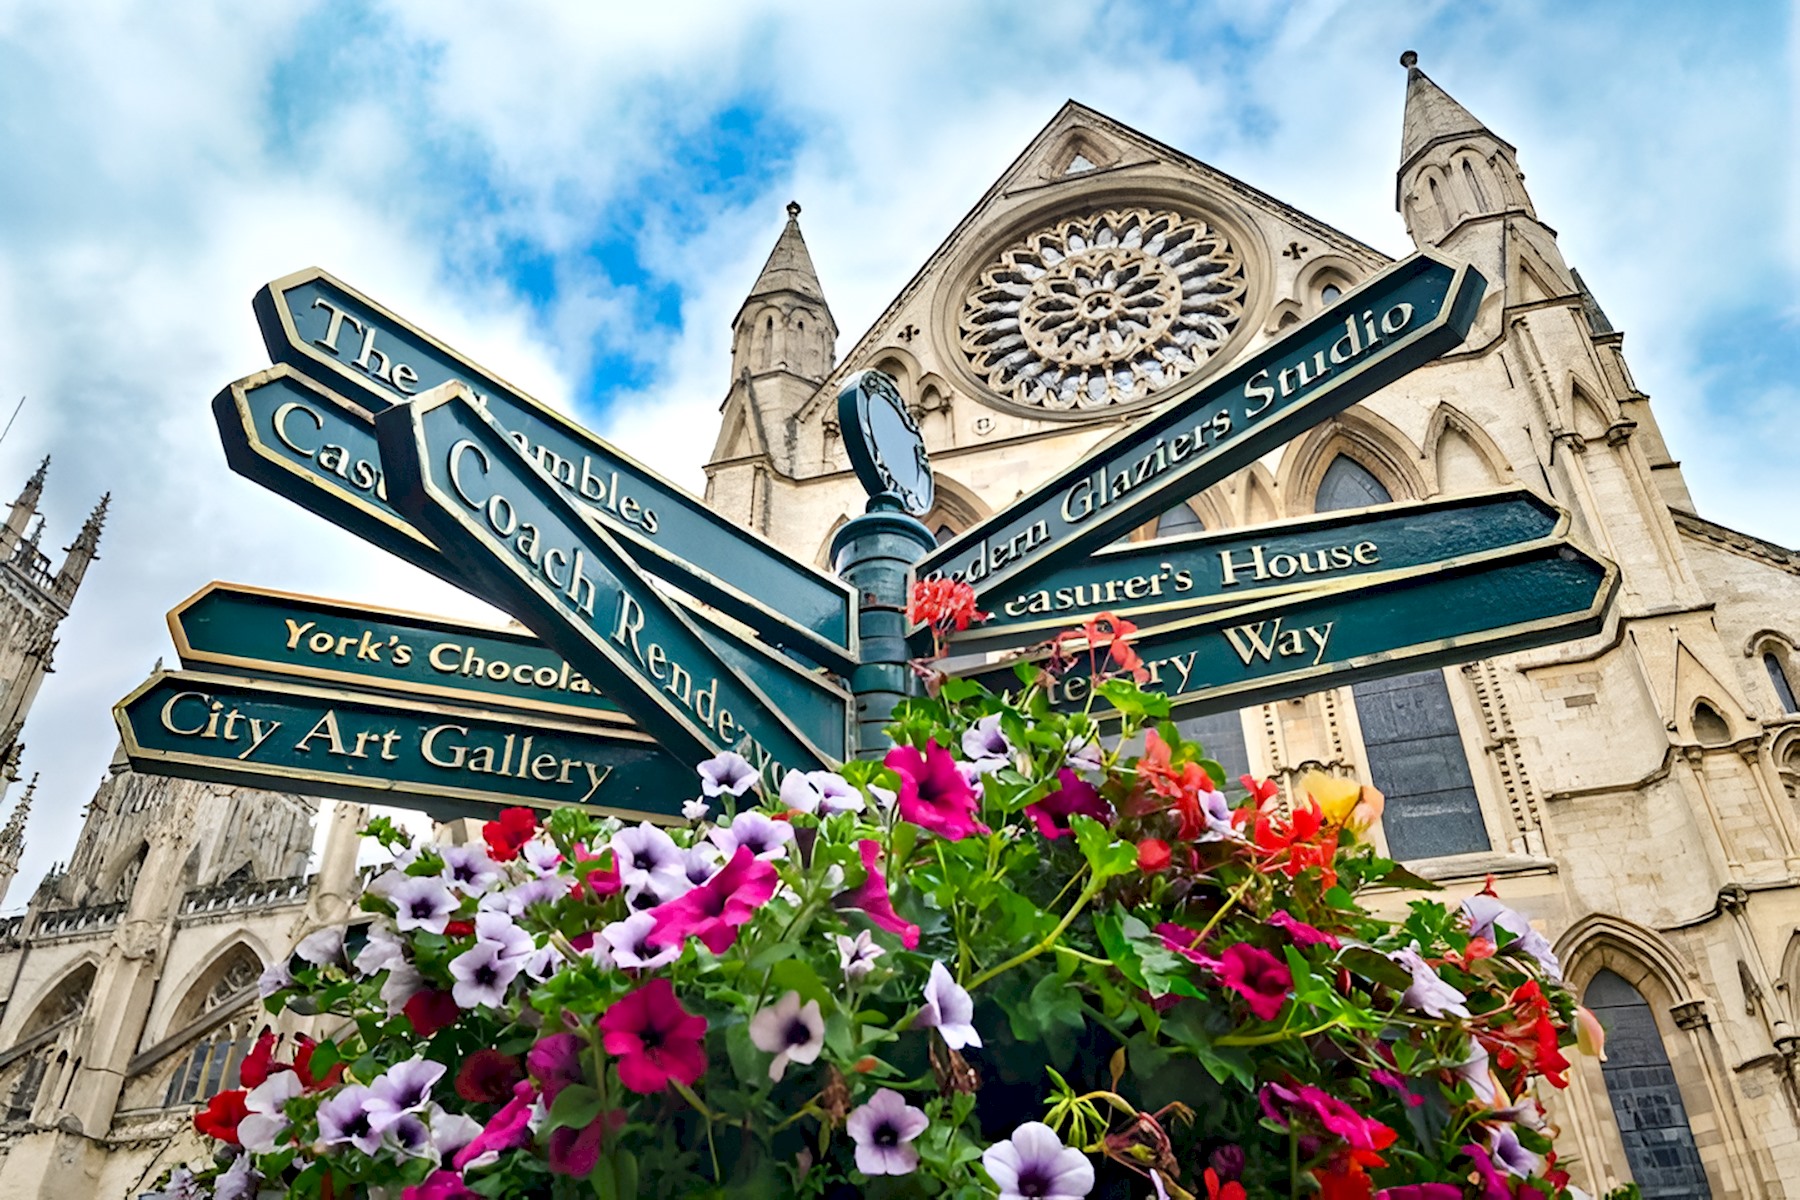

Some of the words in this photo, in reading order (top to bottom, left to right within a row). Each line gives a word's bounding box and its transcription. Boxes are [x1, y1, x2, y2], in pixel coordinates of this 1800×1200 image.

[311, 297, 419, 394] The
[478, 394, 659, 534] mbles
[1060, 407, 1232, 524] Glaziers
[1243, 301, 1414, 418] Studio
[448, 440, 596, 620] Coach
[1004, 563, 1194, 617] easurer's
[1218, 540, 1380, 588] House
[284, 618, 412, 665] York's
[428, 643, 602, 695] Chocola
[1223, 618, 1335, 666] Way
[160, 691, 281, 759] City
[295, 709, 400, 761] Art
[420, 724, 614, 802] Gallery
